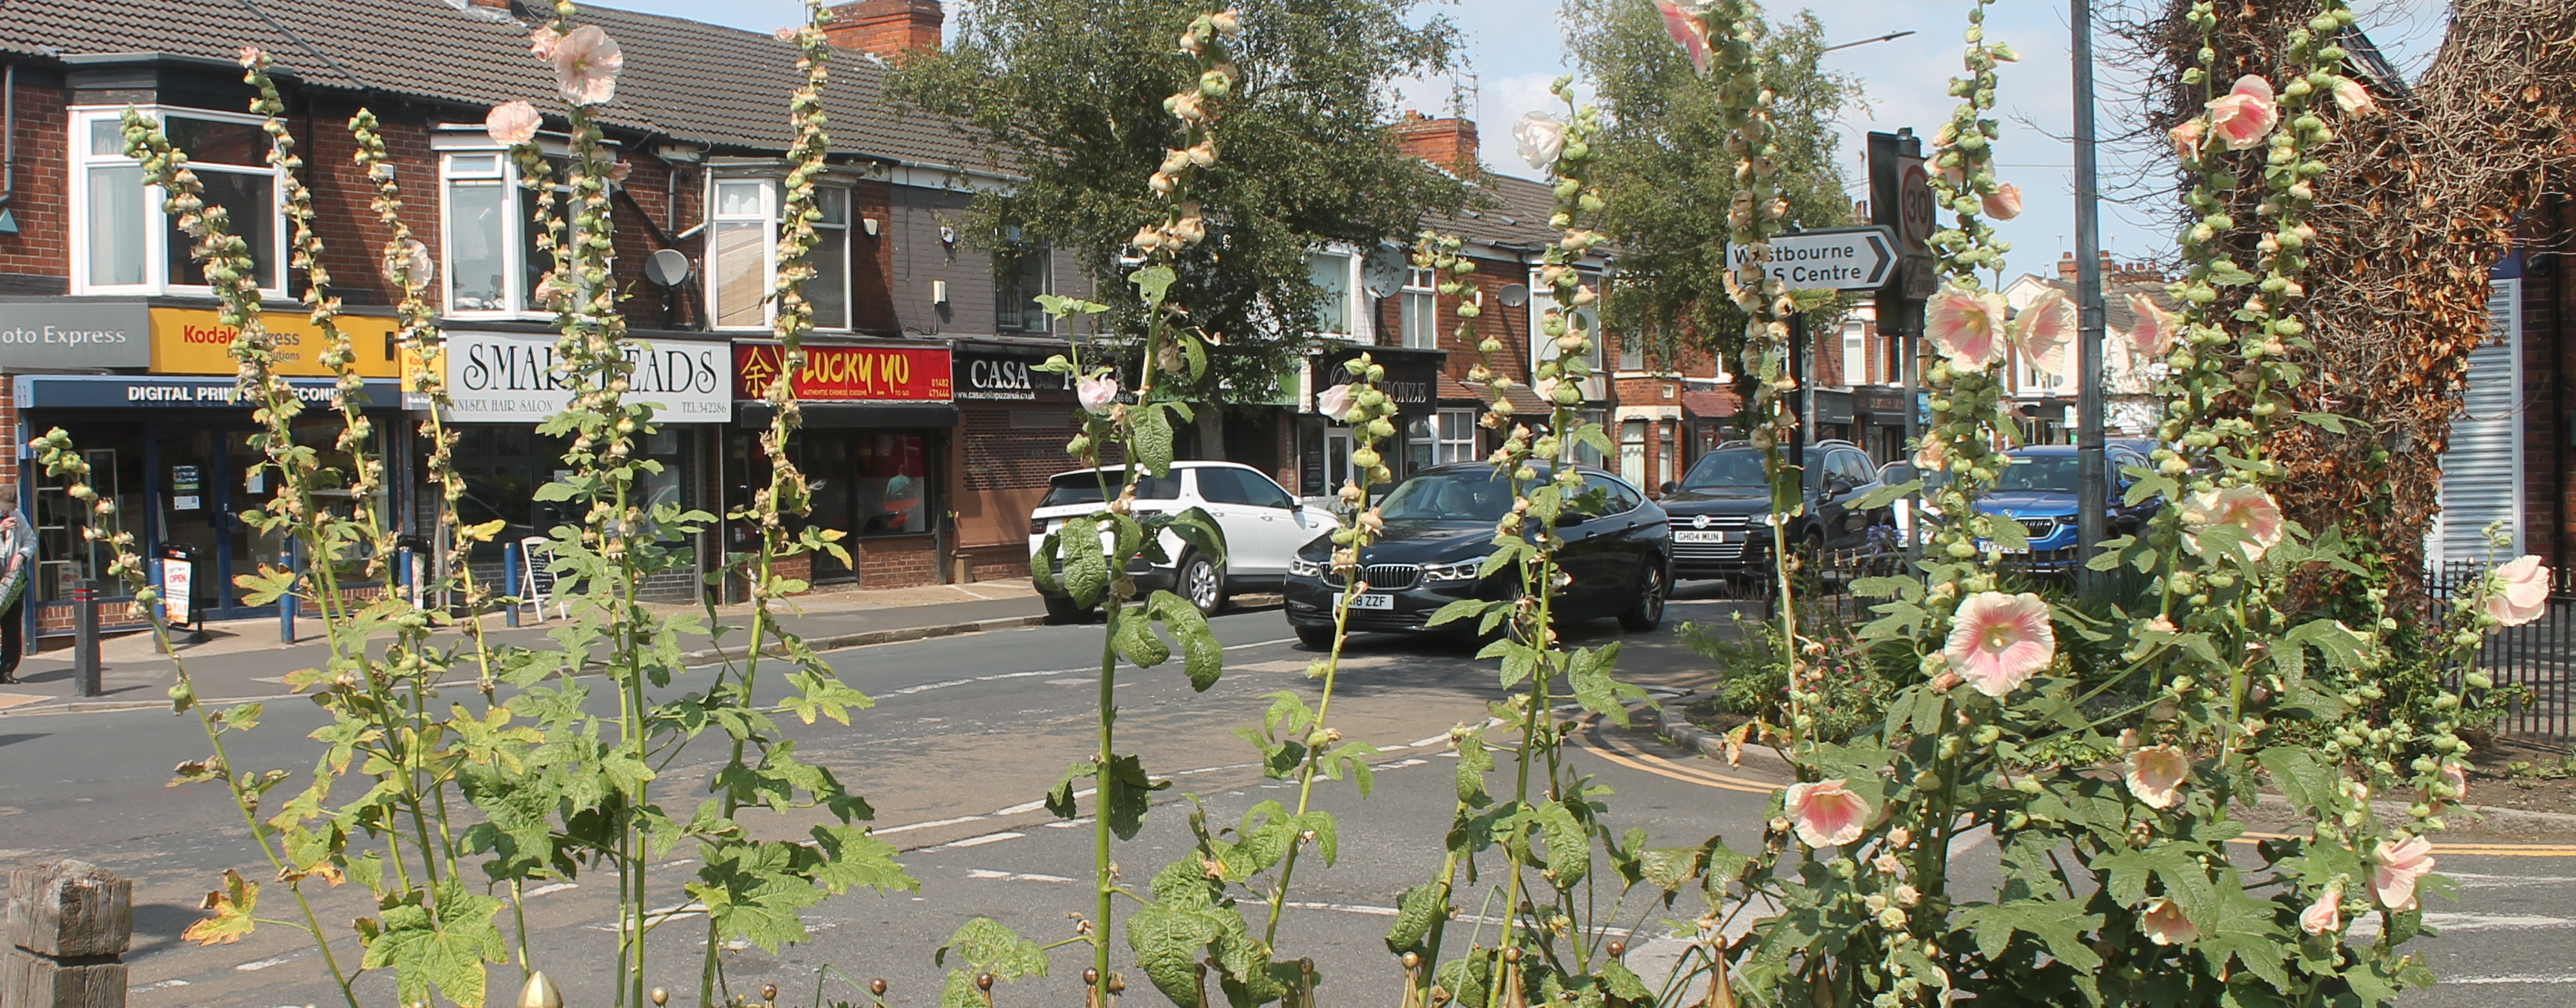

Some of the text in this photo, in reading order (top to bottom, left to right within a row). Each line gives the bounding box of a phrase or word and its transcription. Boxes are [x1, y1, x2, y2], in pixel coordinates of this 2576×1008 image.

[1907, 189, 1928, 223] 30
[1734, 246, 1855, 264] Wstbourne
[1792, 266, 1862, 283] Centre
[43, 325, 127, 348] Express
[802, 351, 910, 394] LUCKY YU
[971, 360, 1031, 389] CASA
[932, 378, 949, 387] 01482
[128, 386, 193, 401] DIGITAL
[929, 389, 950, 398] 471444
[451, 399, 553, 413] UNISEX HAIR SALON
[682, 401, 727, 414] TEL.342286
[169, 574, 186, 583] OPEN
[1365, 595, 1386, 607] ZZF
